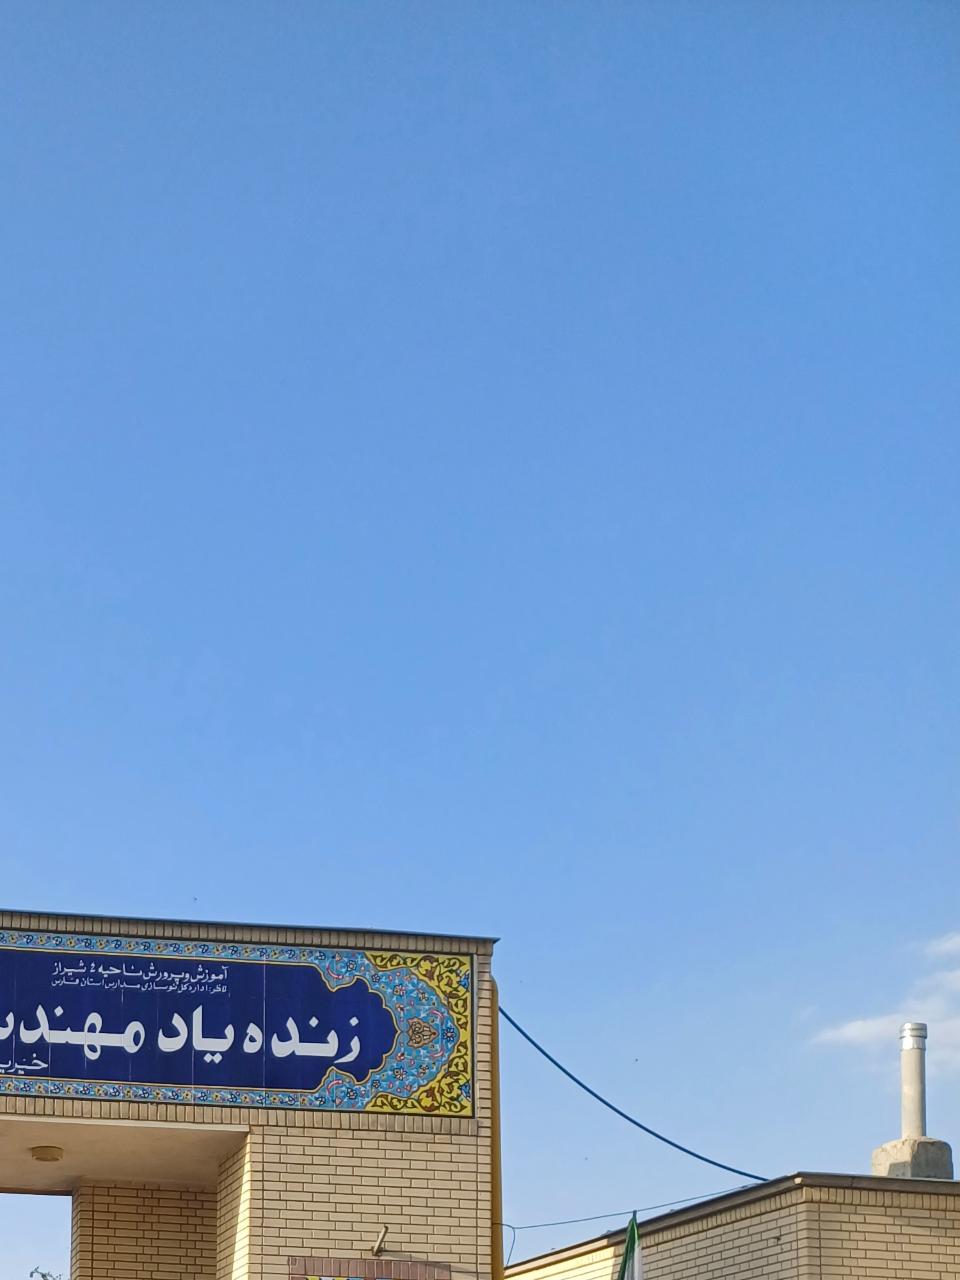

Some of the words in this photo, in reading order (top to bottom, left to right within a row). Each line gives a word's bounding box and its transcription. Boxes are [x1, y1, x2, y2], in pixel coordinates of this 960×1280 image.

[52, 960, 87, 976] شیراز
[98, 962, 142, 978] ناحیه
[143, 962, 184, 984] پرورش
[190, 964, 229, 982] آموزش
[51, 976, 79, 986] فارس
[80, 978, 105, 987] استان
[105, 979, 140, 989] مدارس
[157, 1005, 235, 1064] یاد
[242, 1015, 361, 1064] زنده
